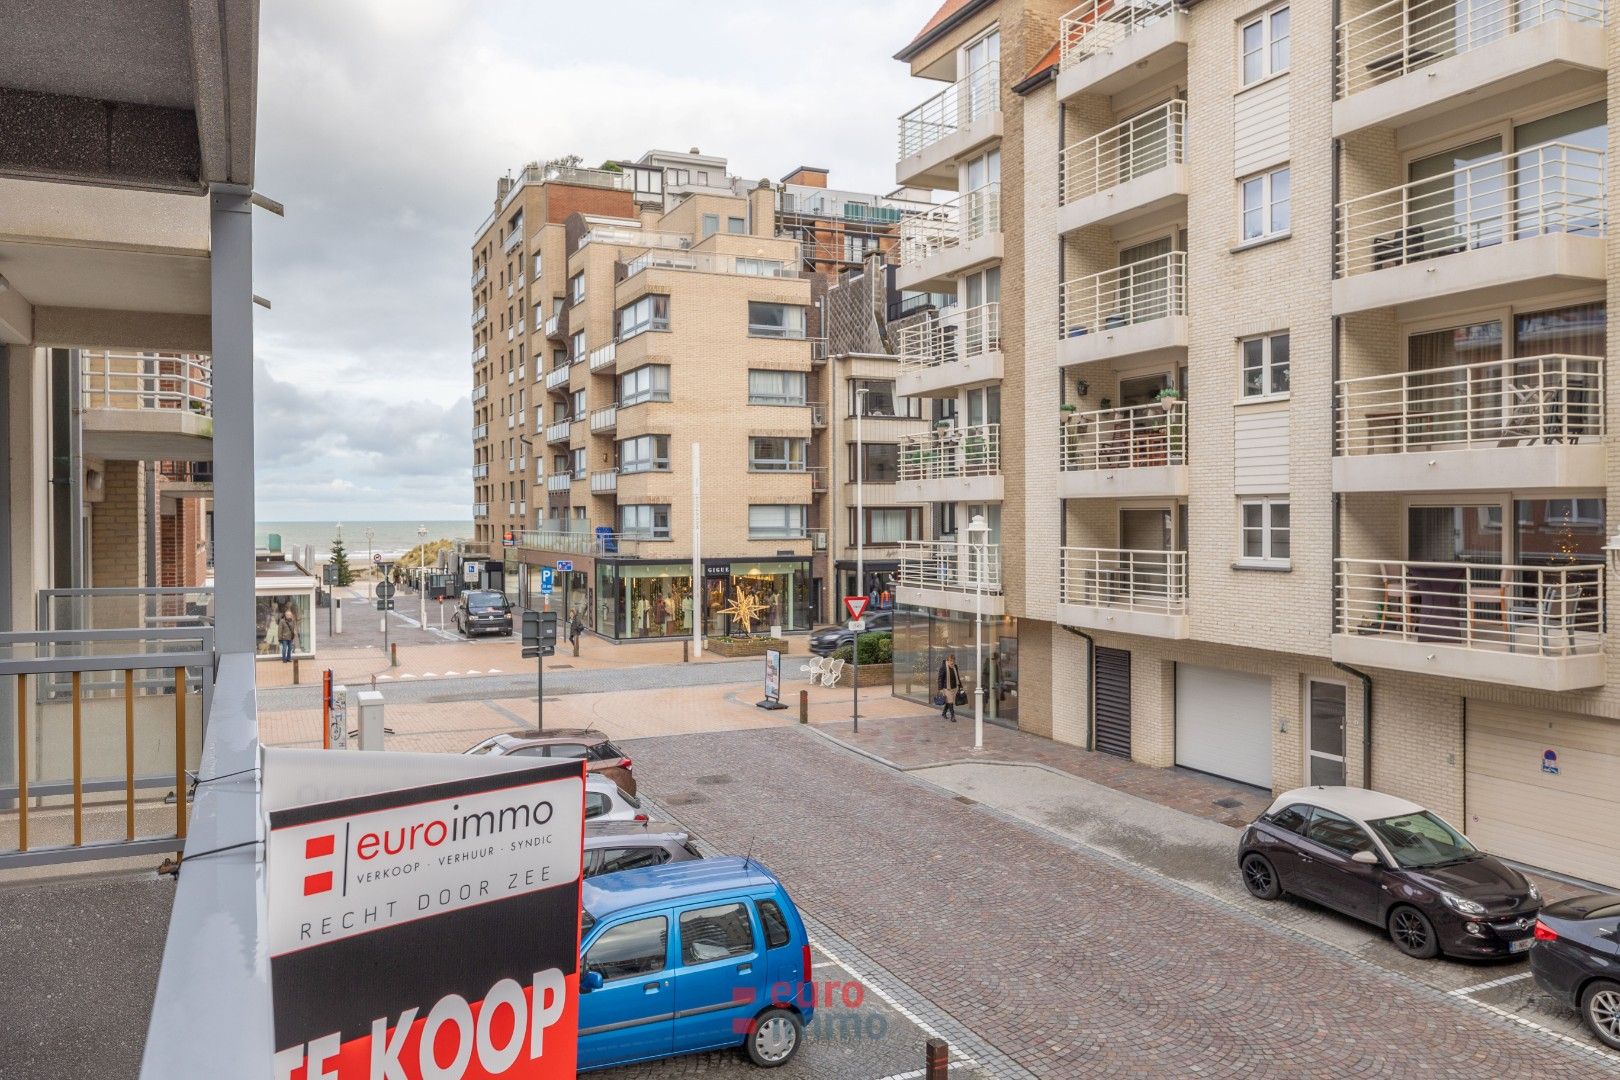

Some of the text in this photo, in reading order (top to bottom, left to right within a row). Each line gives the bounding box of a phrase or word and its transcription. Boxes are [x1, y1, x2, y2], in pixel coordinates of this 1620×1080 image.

[542, 570, 551, 582] P
[707, 566, 730, 574] GIGUE
[357, 800, 554, 860] euroimmo
[357, 834, 553, 884] VERKOOP VERHUUR SYNDIC
[300, 865, 551, 940] RECHT DOOR ZEE
[370, 967, 567, 1080] KOOP
